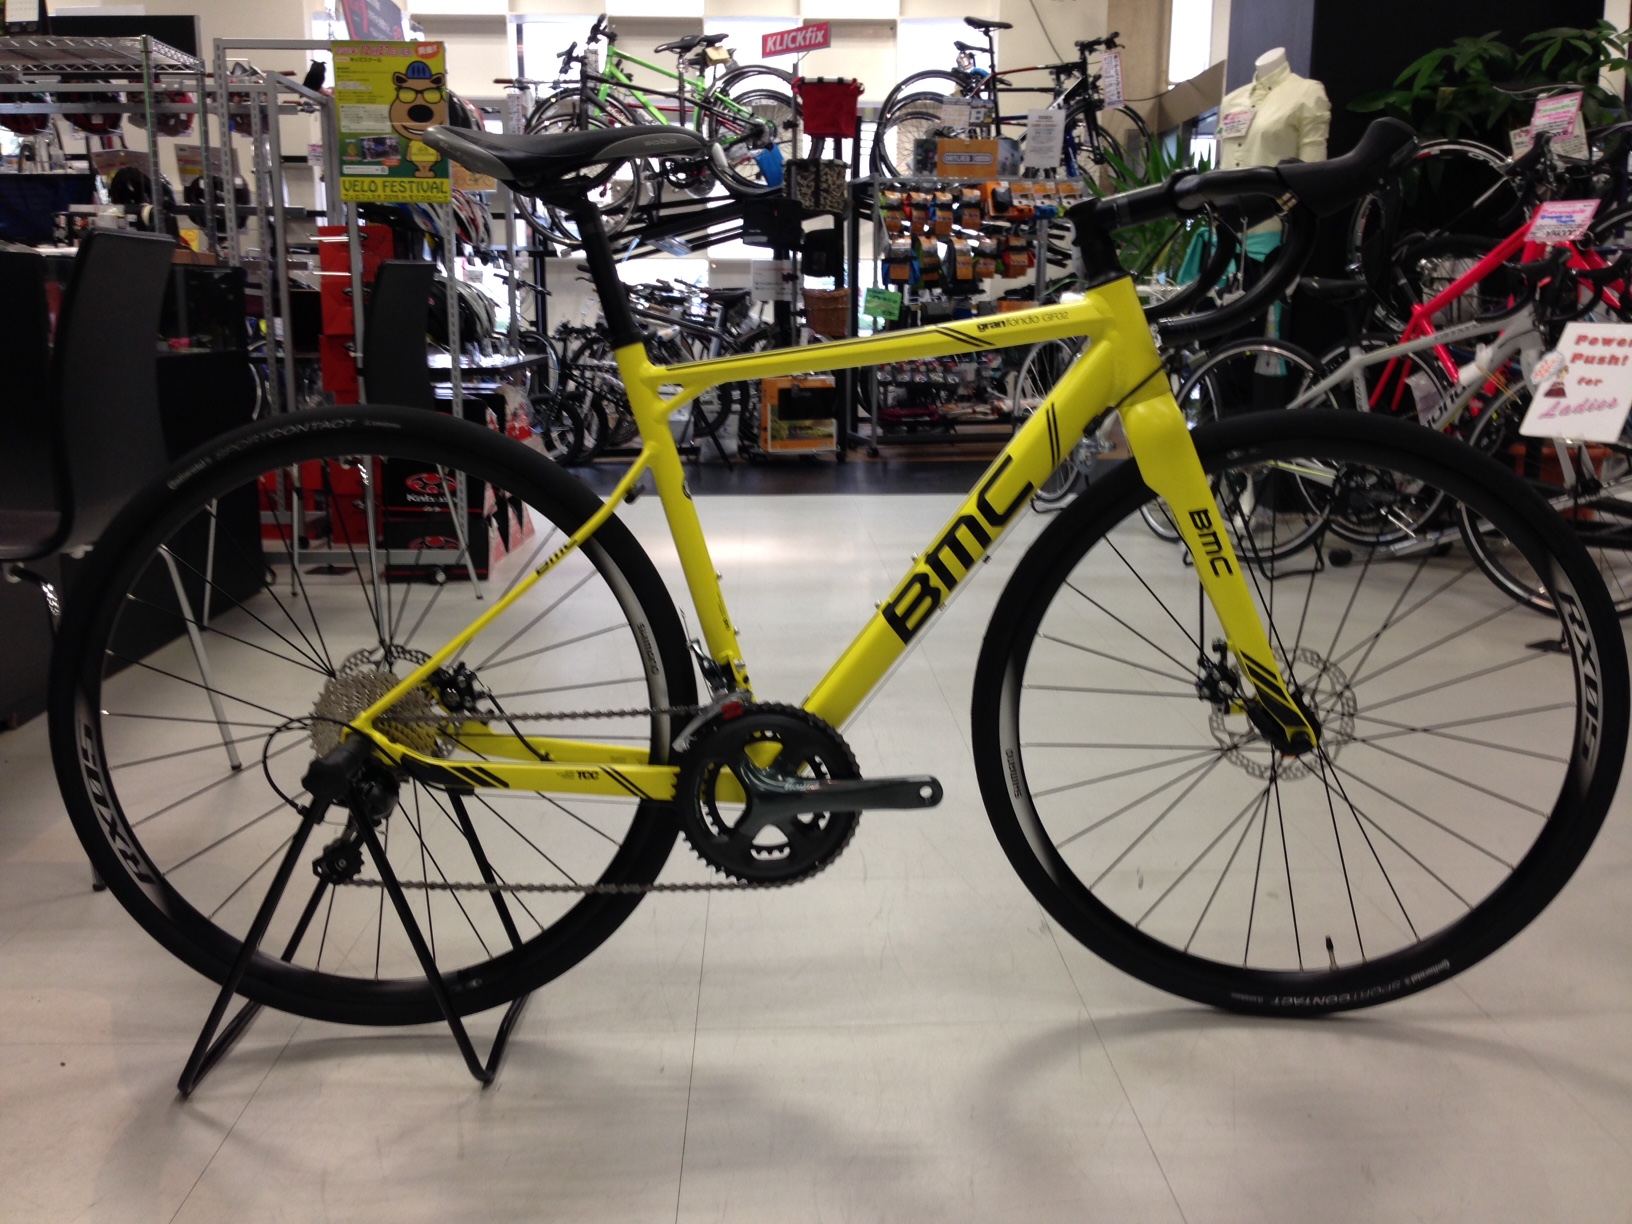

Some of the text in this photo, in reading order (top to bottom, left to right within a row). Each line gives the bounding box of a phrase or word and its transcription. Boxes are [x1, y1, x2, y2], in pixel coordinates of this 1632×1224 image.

[766, 27, 825, 52] KLICKfix
[342, 180, 448, 194] VELO FESTIVAL
[976, 311, 1070, 333] granfondo GF02
[1570, 352, 1630, 366] Push!
[1538, 397, 1619, 420] Ladies
[882, 454, 1034, 645] BMC
[1188, 509, 1234, 577] BMC
